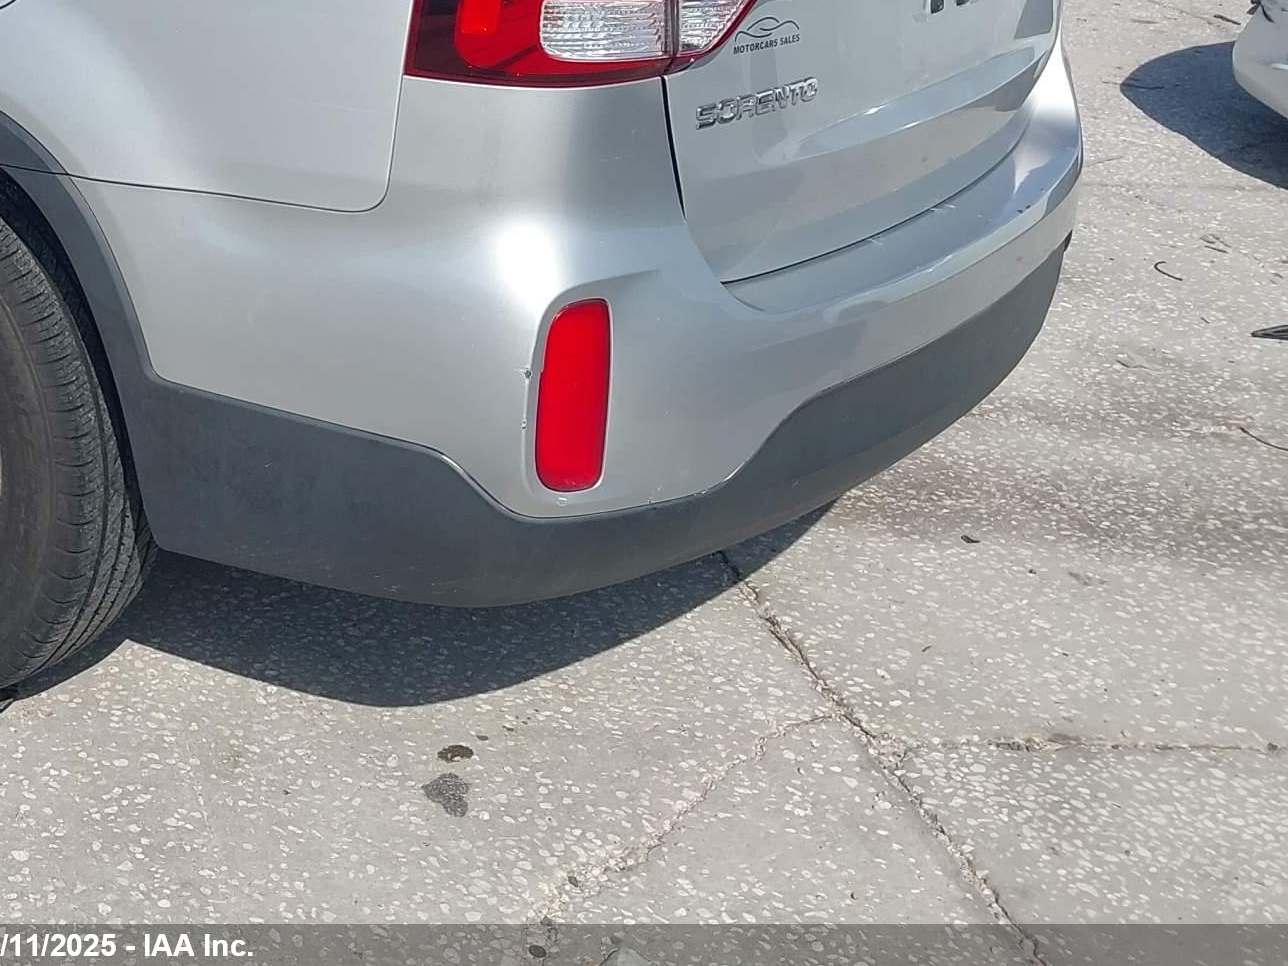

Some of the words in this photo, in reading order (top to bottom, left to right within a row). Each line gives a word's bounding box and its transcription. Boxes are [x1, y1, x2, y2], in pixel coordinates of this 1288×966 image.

[733, 38, 779, 54] MOTORCARS
[779, 33, 800, 46] SALES
[696, 76, 818, 130] SORENTO
